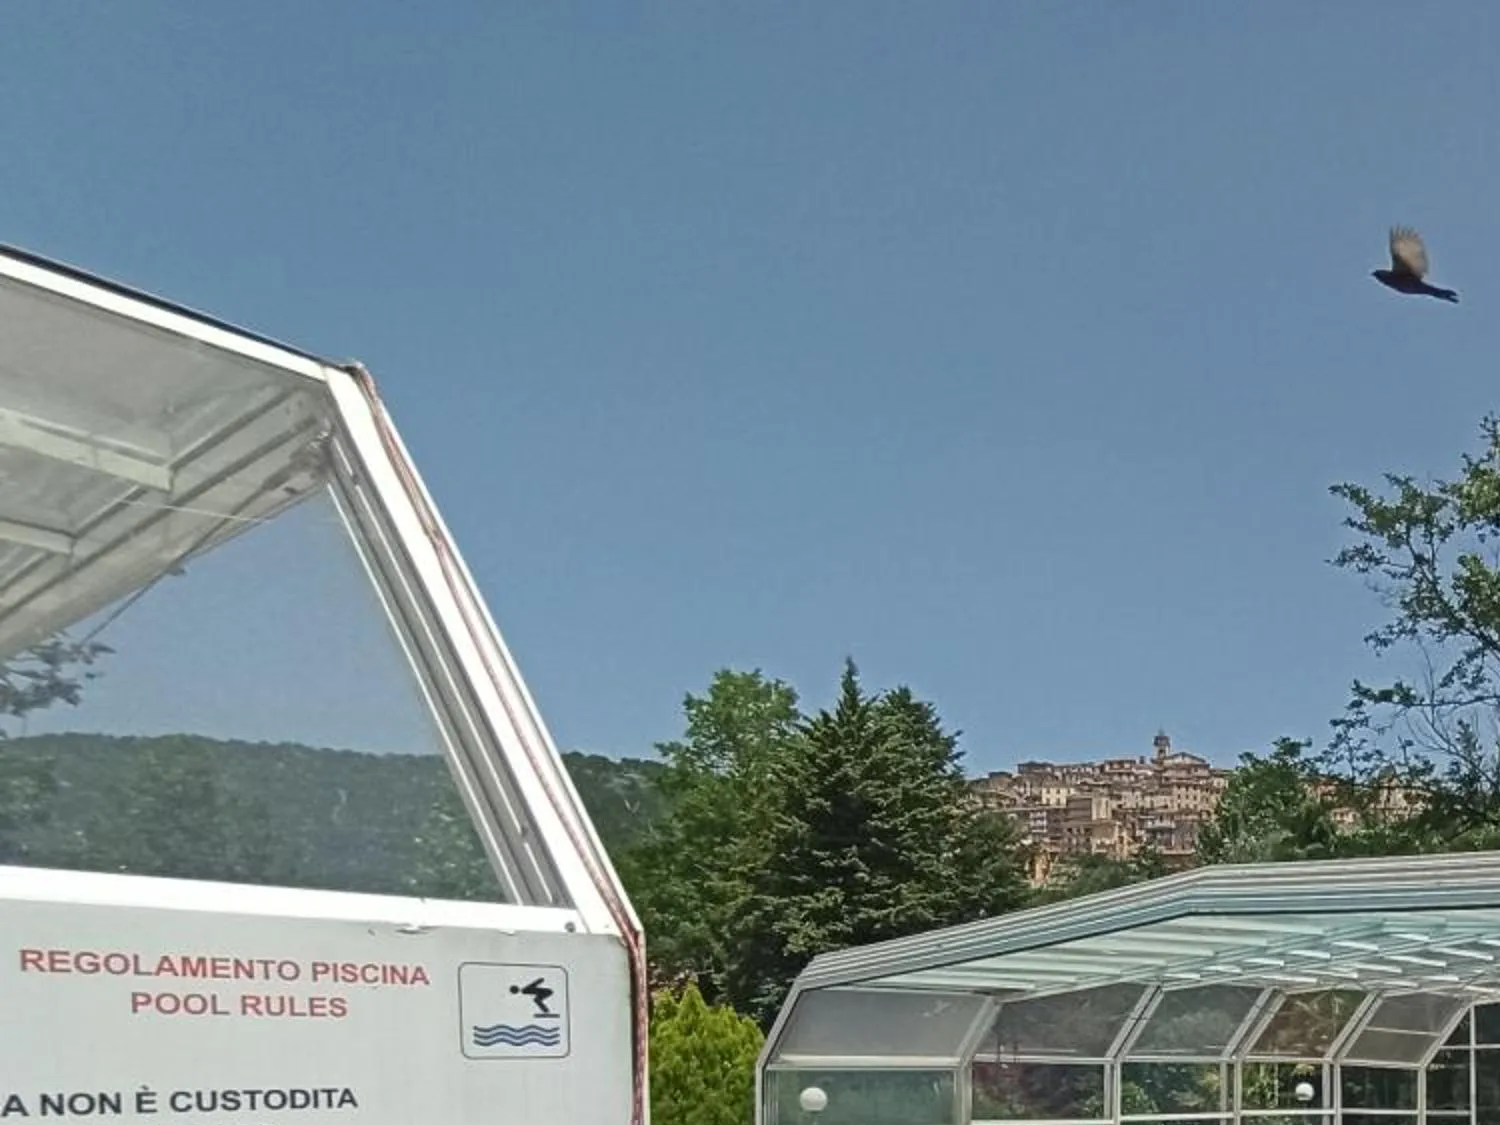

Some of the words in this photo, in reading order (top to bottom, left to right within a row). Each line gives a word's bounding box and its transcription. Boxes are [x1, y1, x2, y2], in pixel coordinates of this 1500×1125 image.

[19, 949, 301, 982] REGOLAMENTO
[311, 961, 430, 985] PISCINA
[131, 991, 230, 1015] POOL
[240, 994, 348, 1018] RULES
[40, 1091, 122, 1116] NON
[136, 1084, 158, 1114] È
[169, 1087, 358, 1113] CUSTODITA
